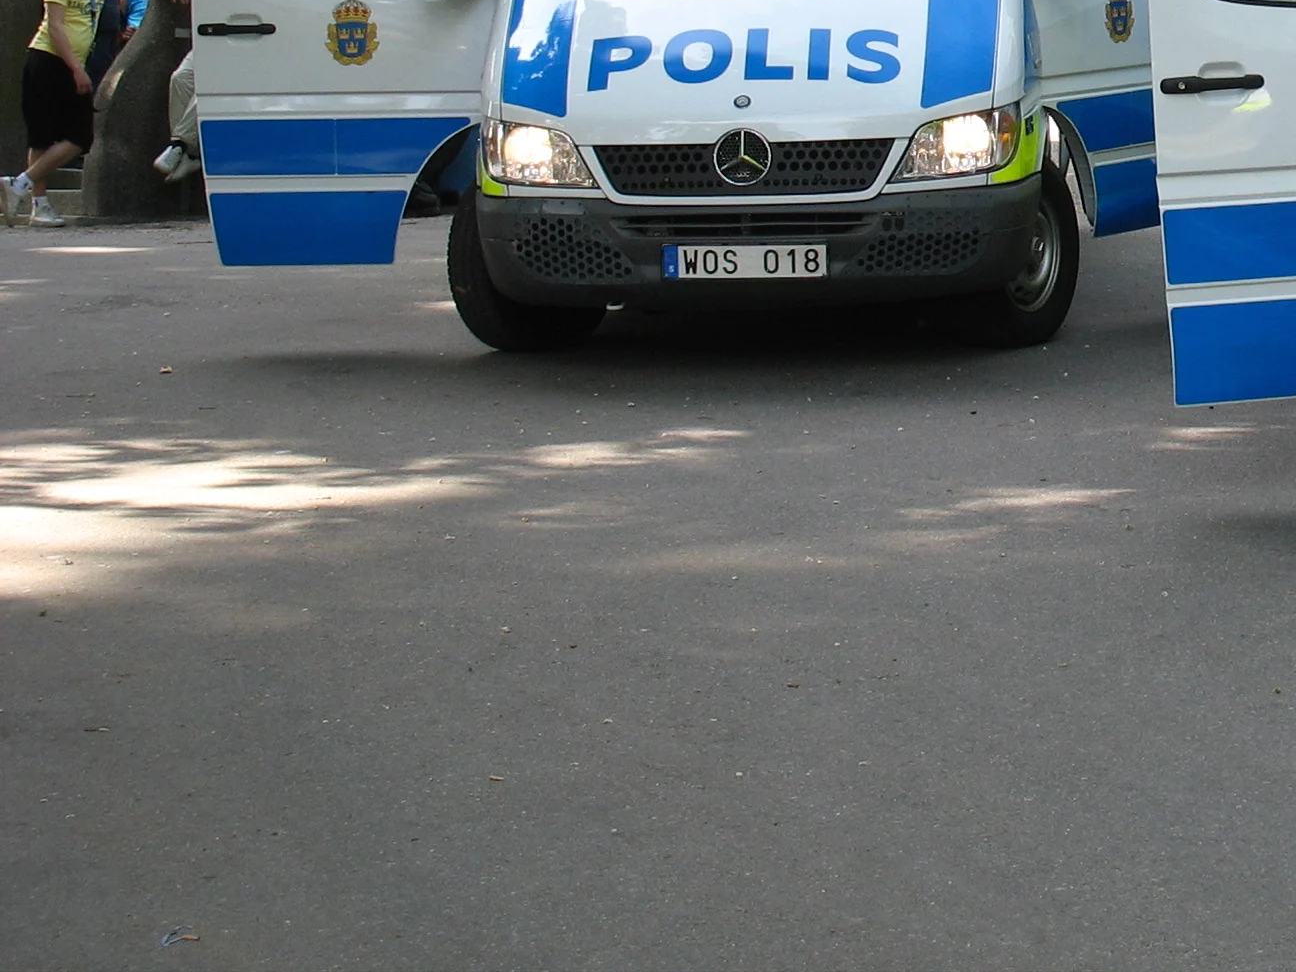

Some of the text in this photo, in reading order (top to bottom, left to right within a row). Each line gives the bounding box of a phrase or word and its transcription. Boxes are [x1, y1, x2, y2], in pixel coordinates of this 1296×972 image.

[587, 28, 901, 92] POLIS
[683, 249, 738, 275] WOS
[763, 248, 820, 274] 018
